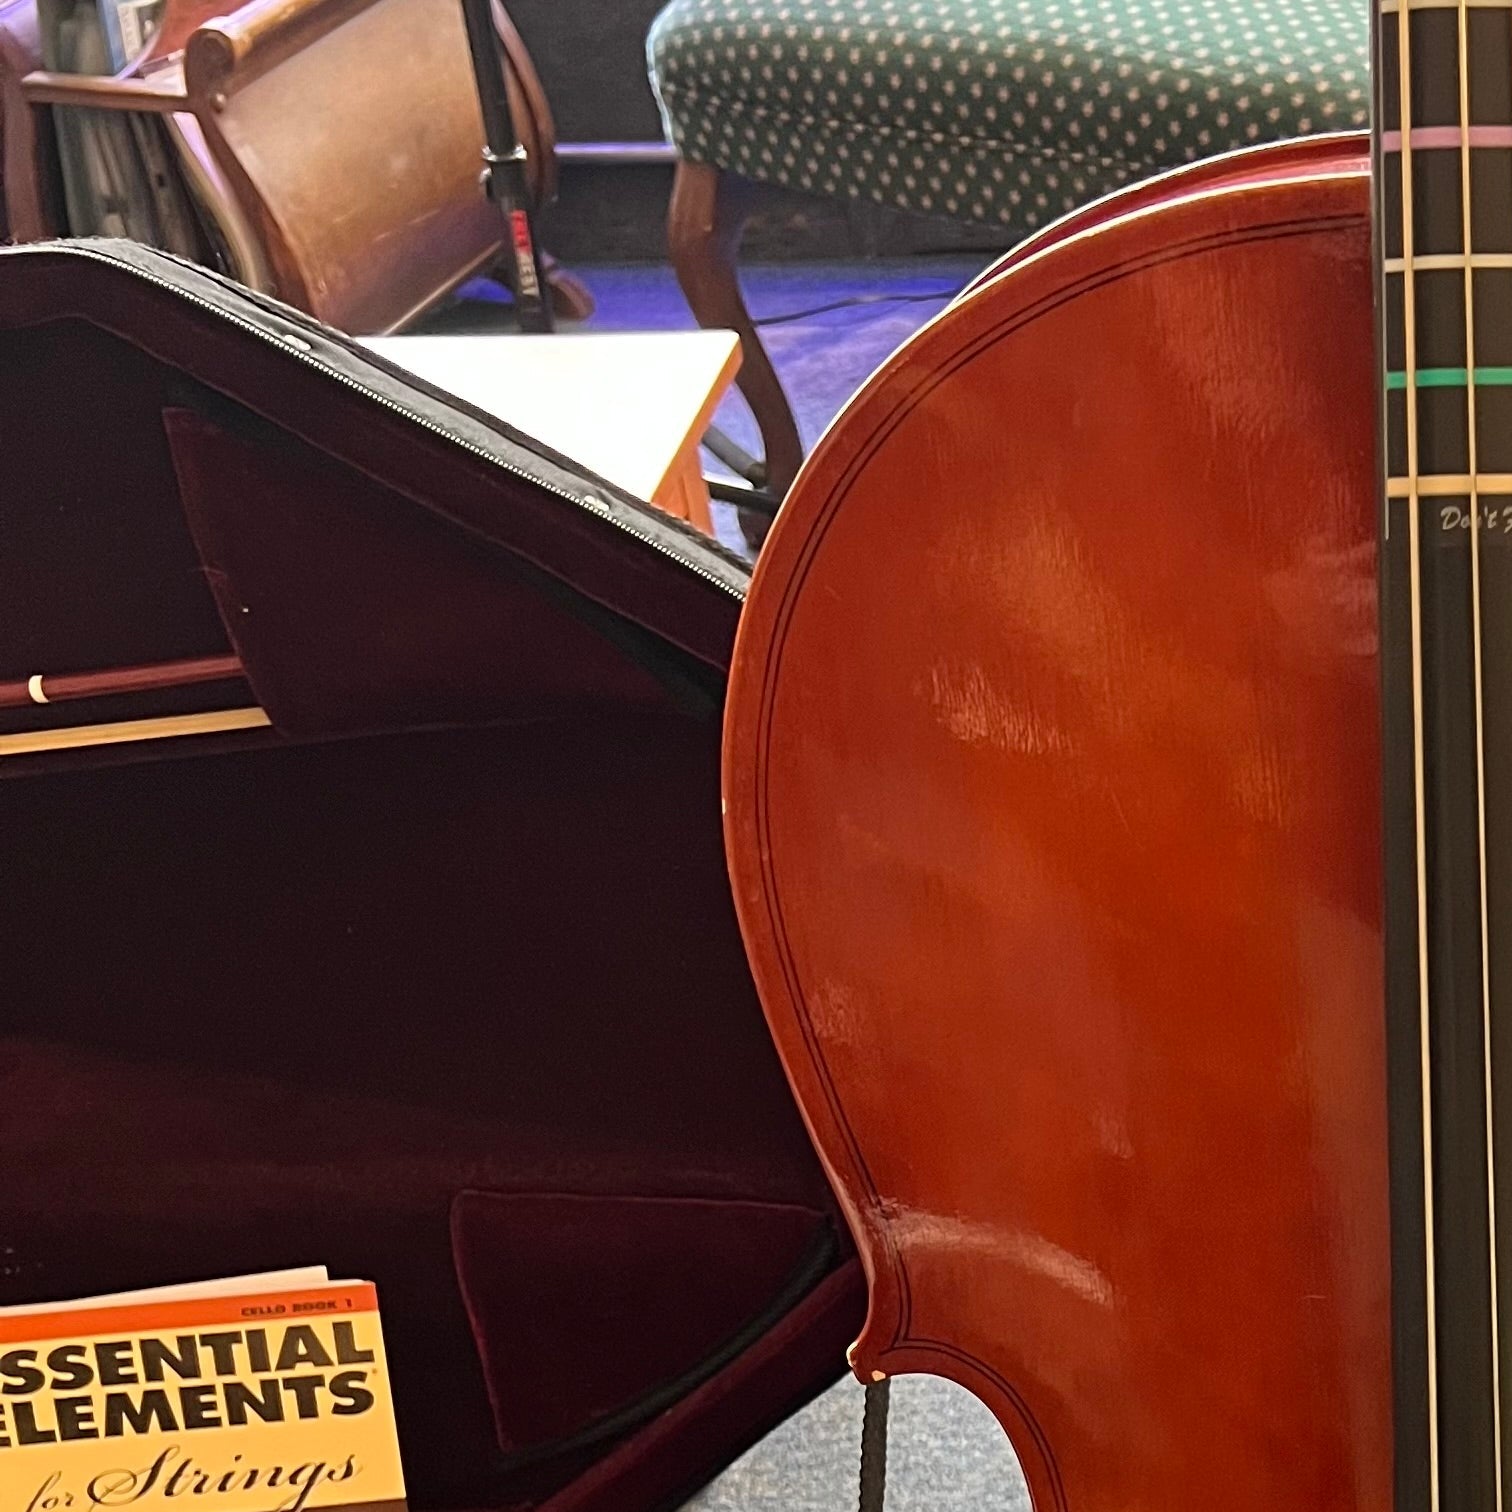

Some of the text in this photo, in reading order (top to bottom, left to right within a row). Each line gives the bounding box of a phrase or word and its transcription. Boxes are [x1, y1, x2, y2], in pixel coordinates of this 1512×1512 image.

[241, 1298, 353, 1317] CELLO BOOK 1
